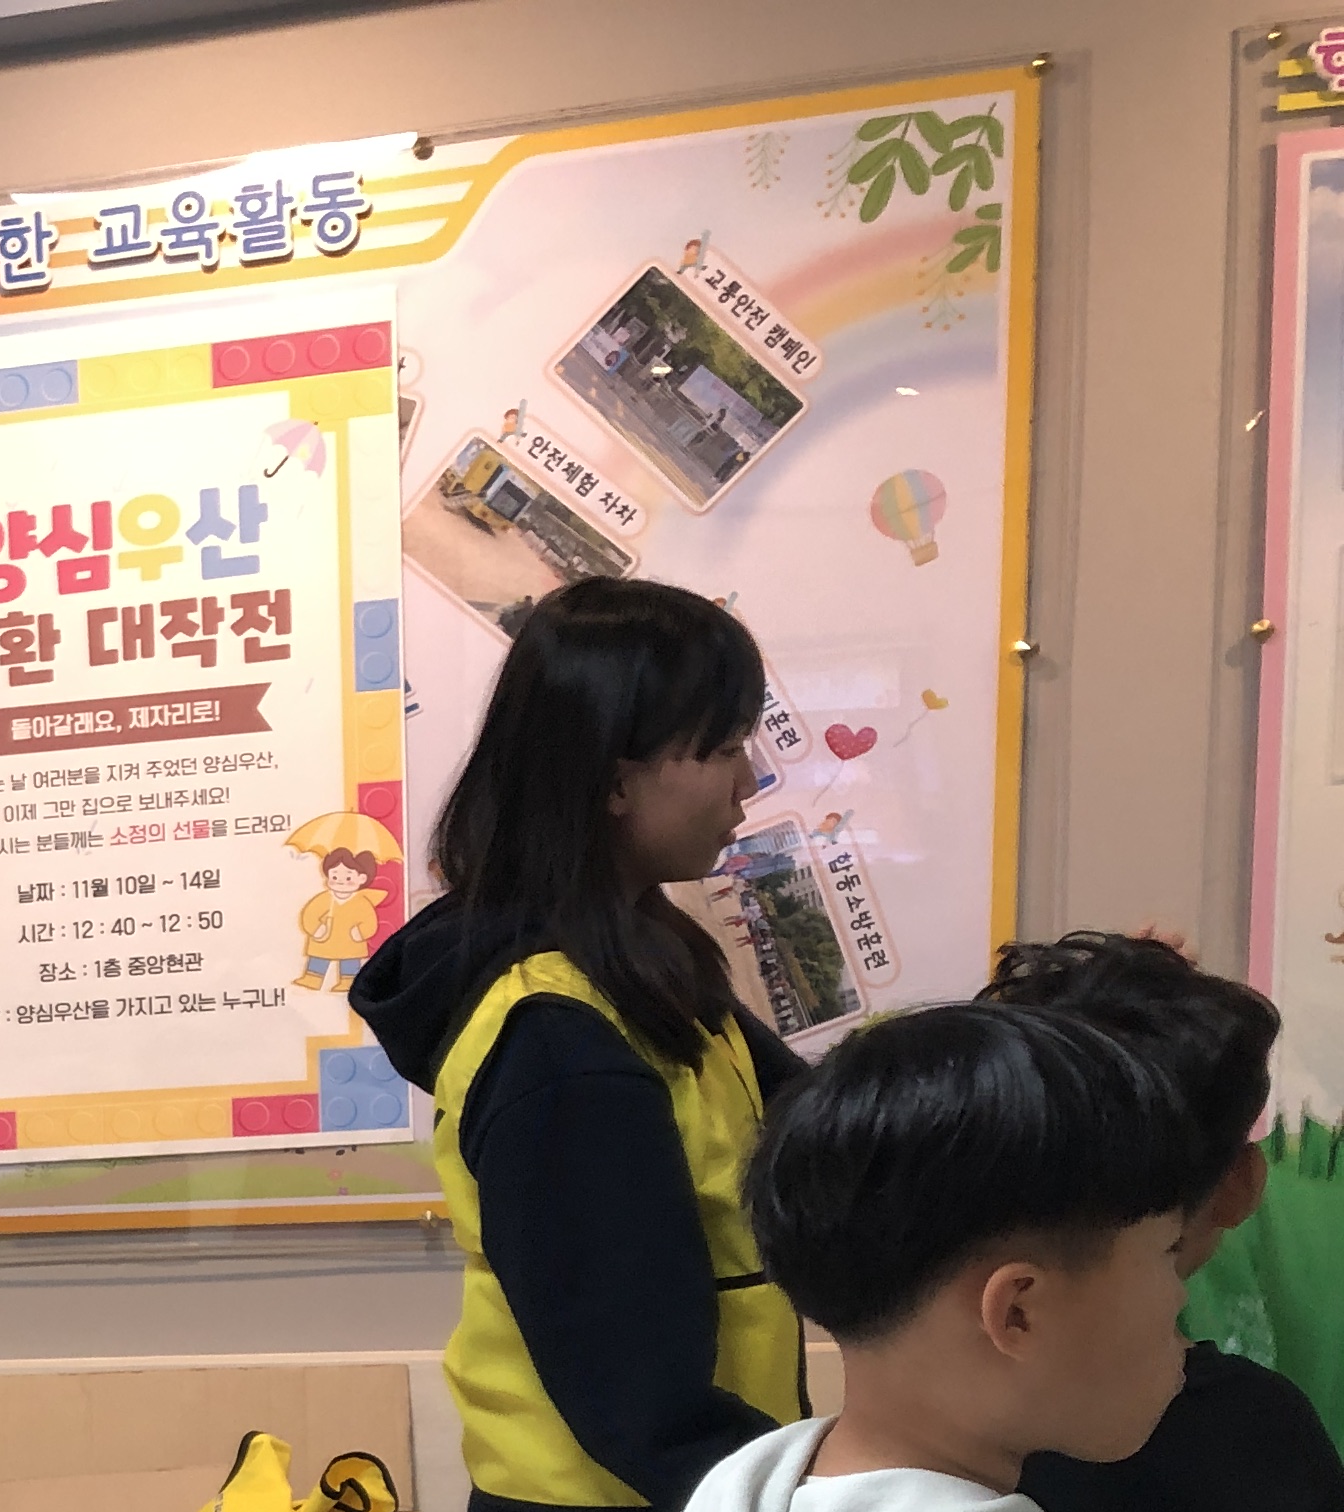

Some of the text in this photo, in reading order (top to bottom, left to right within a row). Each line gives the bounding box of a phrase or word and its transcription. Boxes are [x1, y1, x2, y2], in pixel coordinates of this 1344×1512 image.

[92, 170, 366, 261] 교육활동
[705, 269, 817, 374] 교통안전 캠페인
[527, 436, 600, 497] 안전체험
[86, 589, 292, 668] 대작전
[11, 700, 221, 741] 돌아갈래요, 제자리로!
[764, 683, 801, 751] 피훈련
[10, 773, 27, 792] 날
[33, 766, 101, 789] 여러분을
[106, 762, 140, 782] 지켜
[146, 757, 198, 778] 주었던
[203, 751, 279, 774] 양심우산,
[4, 786, 230, 823] 이제 그만 집으로 보내주세요!
[36, 830, 105, 853] 분들께는
[110, 823, 166, 847] 소정의
[173, 818, 229, 842] 선물을
[234, 814, 292, 837] 드려요!
[17, 883, 55, 904] 날짜
[72, 877, 109, 898] 11월
[115, 874, 156, 896] 10일
[179, 868, 221, 890] 14일
[18, 923, 55, 944] 시간
[72, 920, 94, 940] 12
[111, 917, 135, 937] 40
[159, 913, 181, 933] 12
[198, 910, 223, 930] 50
[828, 851, 890, 971] 합동소방훈련
[39, 963, 77, 983] 장소
[94, 959, 122, 979] 1층
[127, 952, 204, 976] 중앙현관
[17, 999, 110, 1024] 양심우산을
[116, 995, 173, 1017] 가지고
[178, 992, 217, 1014] 있는
[223, 987, 286, 1010] 누구나!
